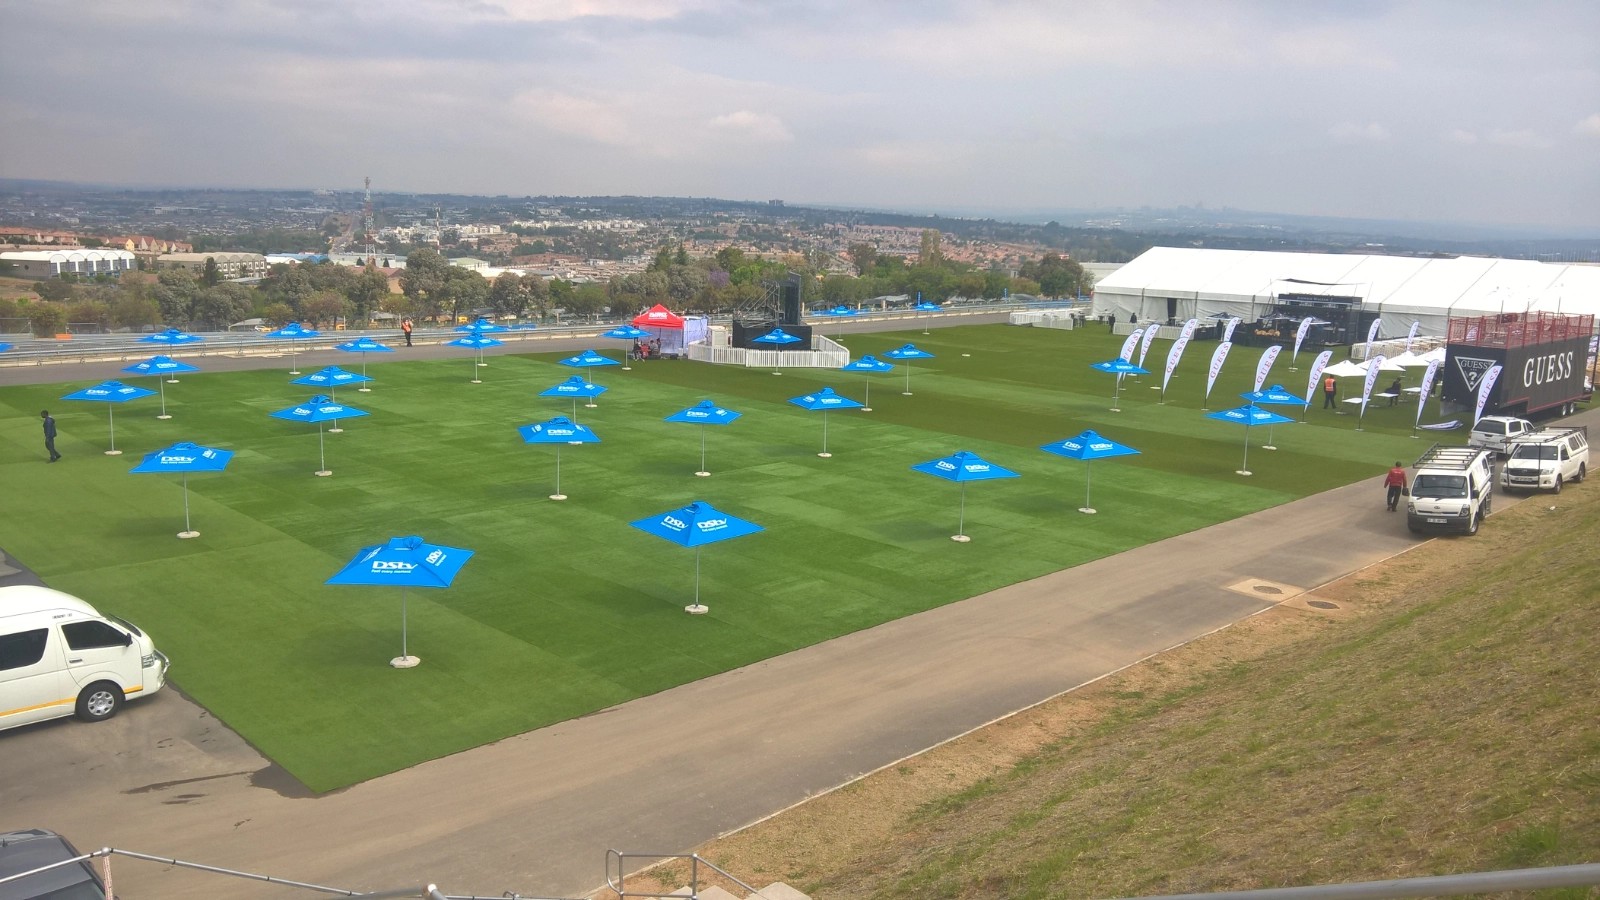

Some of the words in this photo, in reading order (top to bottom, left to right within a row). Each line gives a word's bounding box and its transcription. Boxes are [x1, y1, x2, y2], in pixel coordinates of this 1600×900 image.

[1141, 325, 1157, 356] GUESS
[1167, 338, 1186, 373] GUESS
[1210, 344, 1229, 378] GUESS
[1257, 348, 1278, 384] GUESS
[1309, 353, 1329, 390] GUESS
[1365, 357, 1381, 395] GUESS
[1461, 360, 1488, 370] GUESS
[1524, 351, 1574, 388] GUESS
[1478, 368, 1499, 409] GUESS
[664, 515, 689, 529] DStv
[697, 518, 727, 529] DStv
[372, 560, 418, 570] DStv
